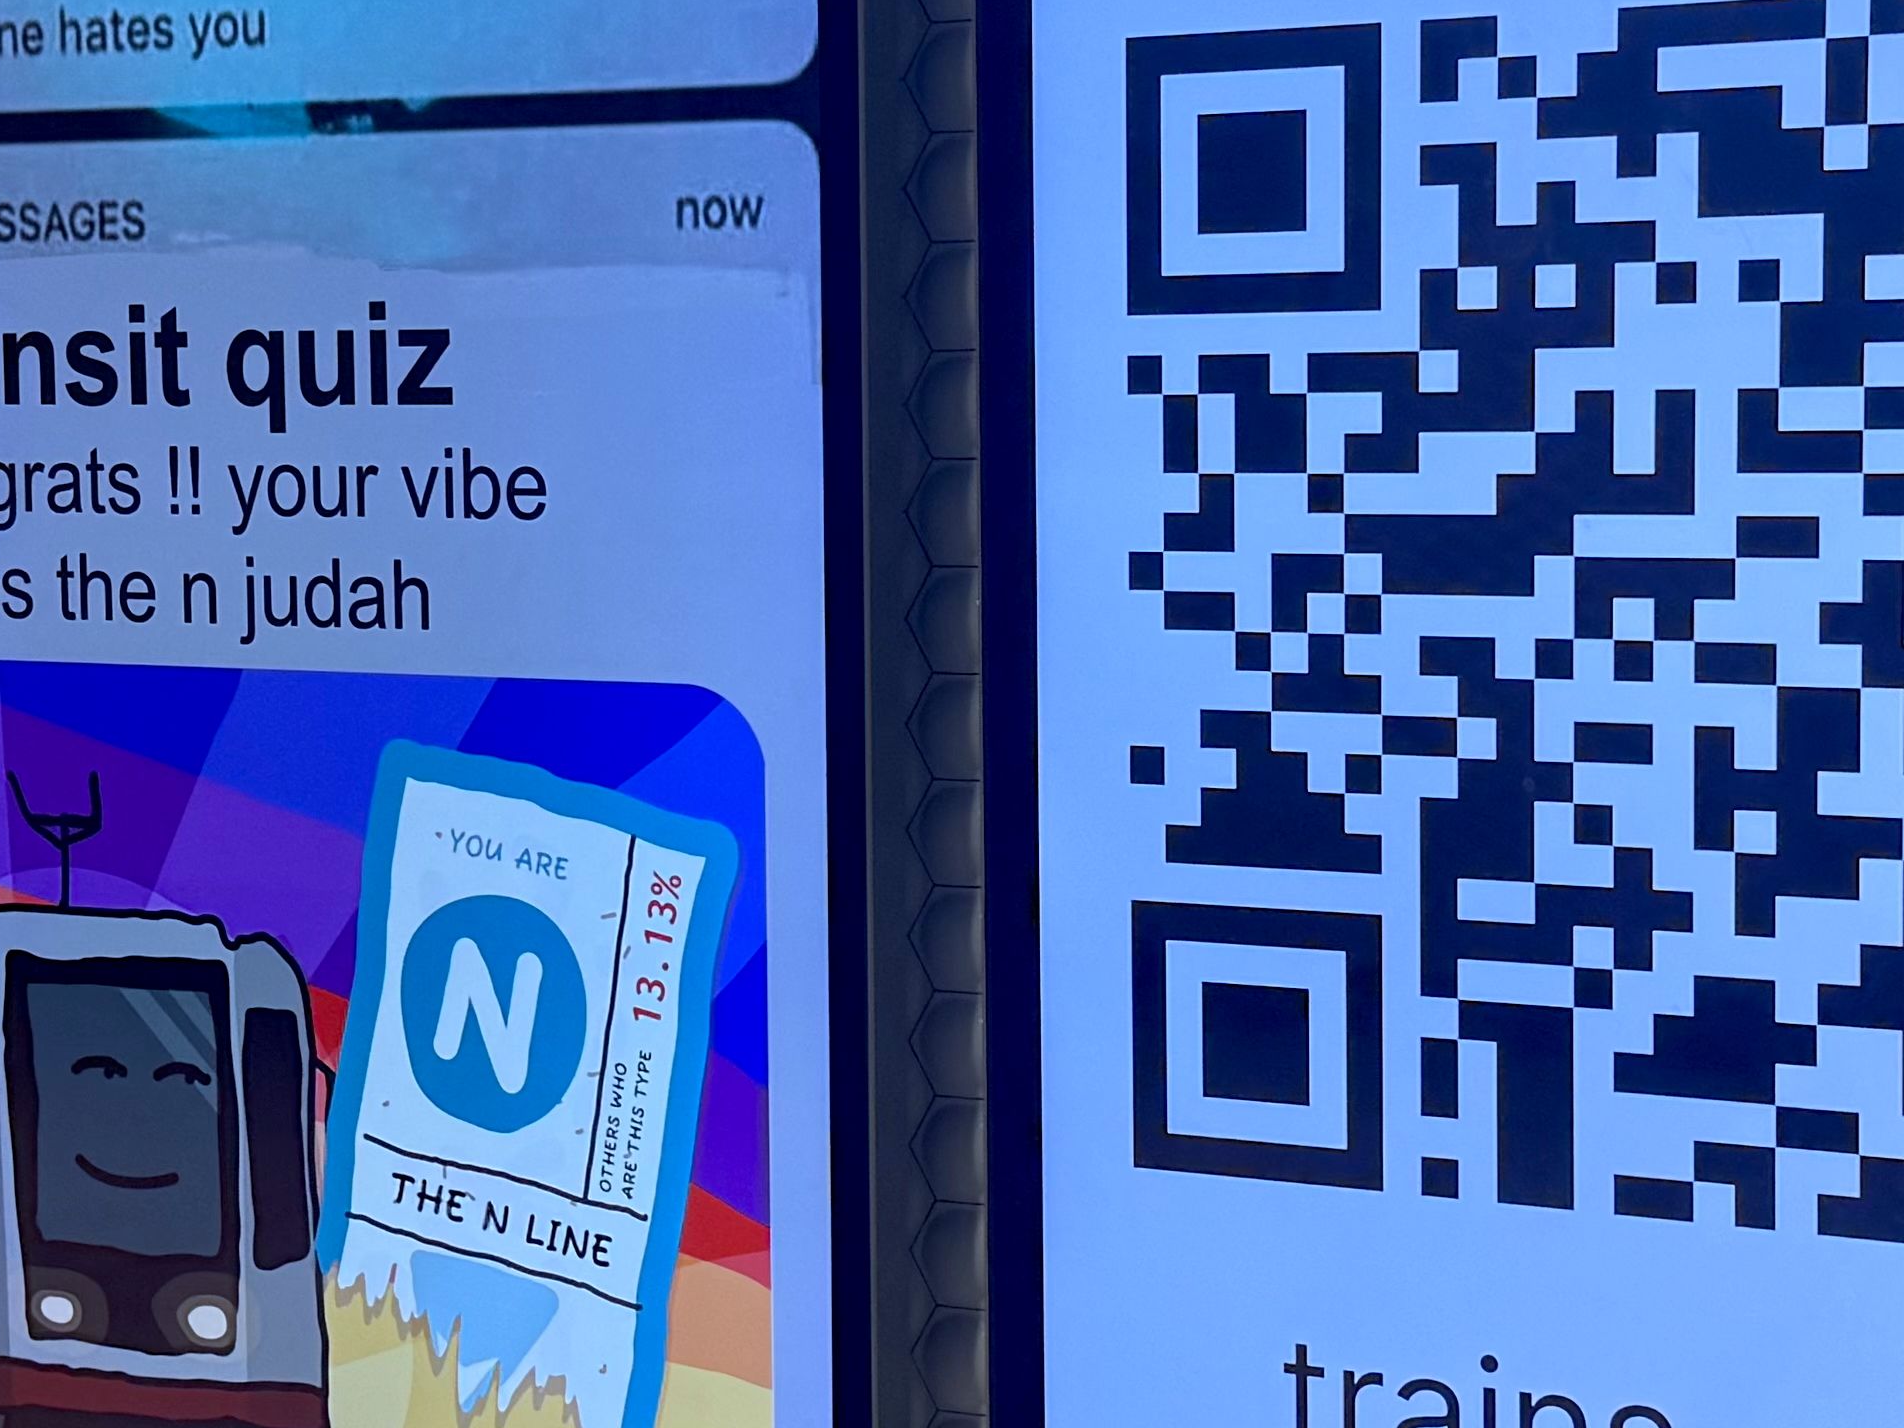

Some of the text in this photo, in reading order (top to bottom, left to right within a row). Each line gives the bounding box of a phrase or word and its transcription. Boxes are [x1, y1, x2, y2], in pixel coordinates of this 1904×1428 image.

[60, 9, 173, 53] hates
[189, 11, 264, 59] you
[677, 196, 763, 229] now
[227, 301, 453, 433] quiz
[170, 446, 200, 514] !!
[228, 465, 378, 535] your
[401, 448, 546, 520] vibe
[57, 553, 155, 622] the
[184, 573, 217, 623] n
[240, 557, 429, 644] judah
[451, 829, 568, 880] YOU ARE
[433, 937, 543, 1095] N
[599, 1062, 628, 1193] OTHERS WHO
[622, 1049, 653, 1199] ARE THIS TYPE
[391, 1172, 613, 1268] THE N LINE
